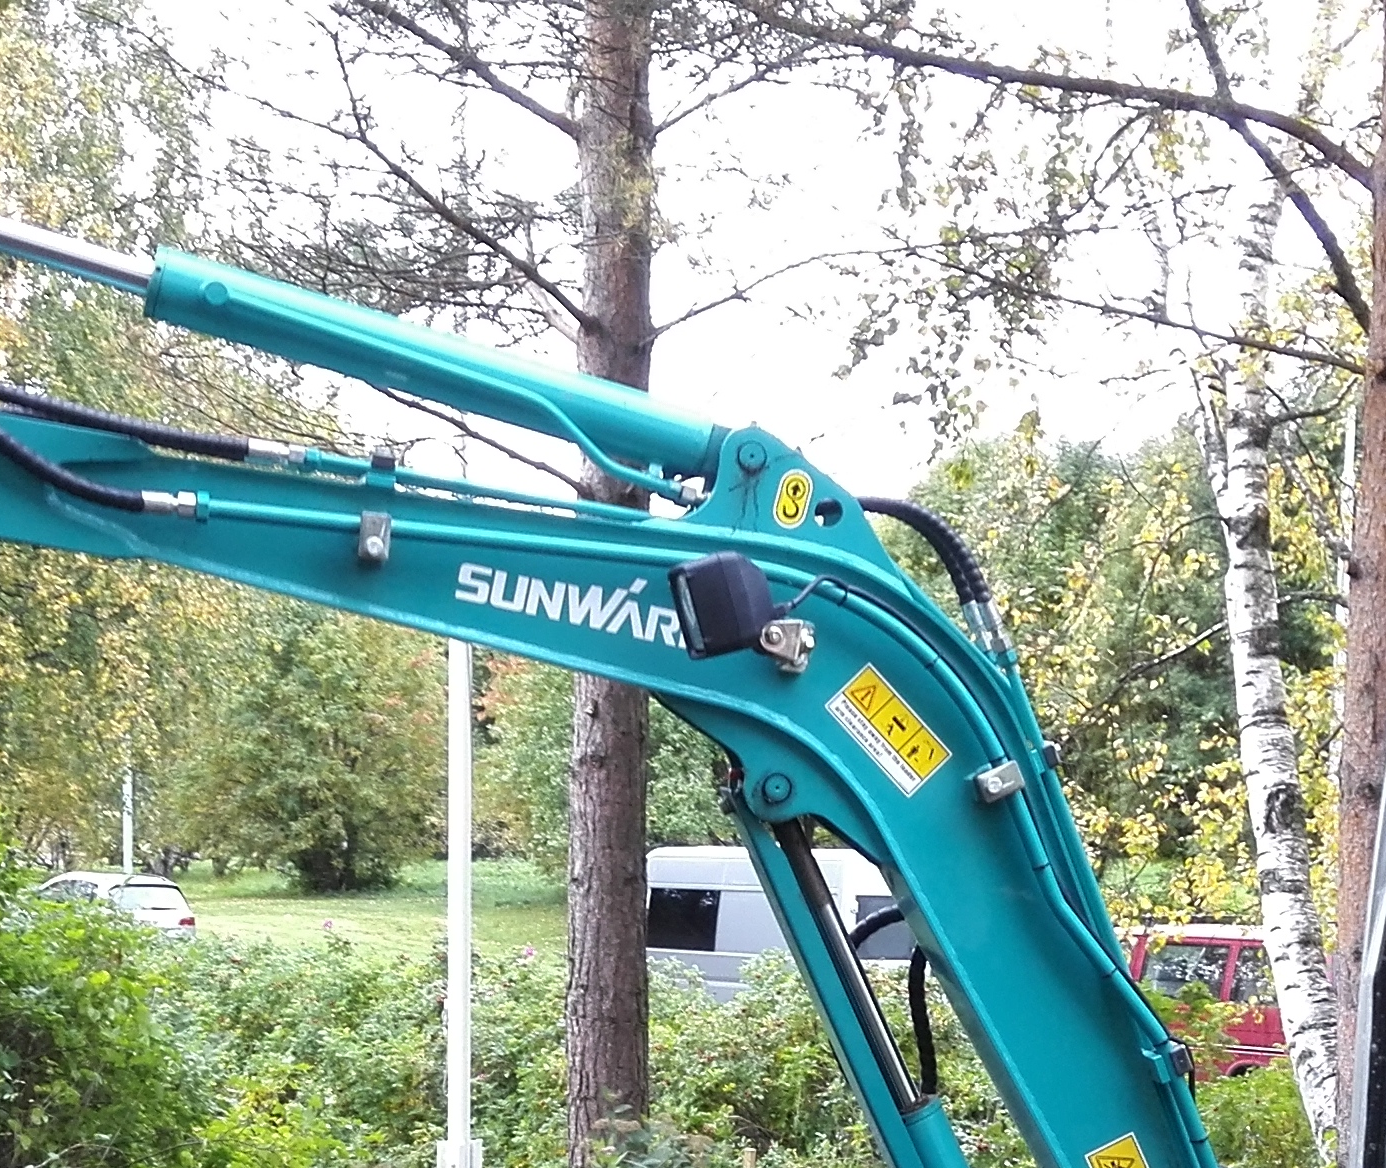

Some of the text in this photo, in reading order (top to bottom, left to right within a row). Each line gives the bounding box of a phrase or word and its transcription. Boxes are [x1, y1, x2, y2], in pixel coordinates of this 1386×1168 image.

[840, 699, 859, 718] Please
[856, 717, 869, 731] stay
[866, 729, 881, 744] away
[879, 742, 893, 756] from
[891, 755, 901, 765] the
